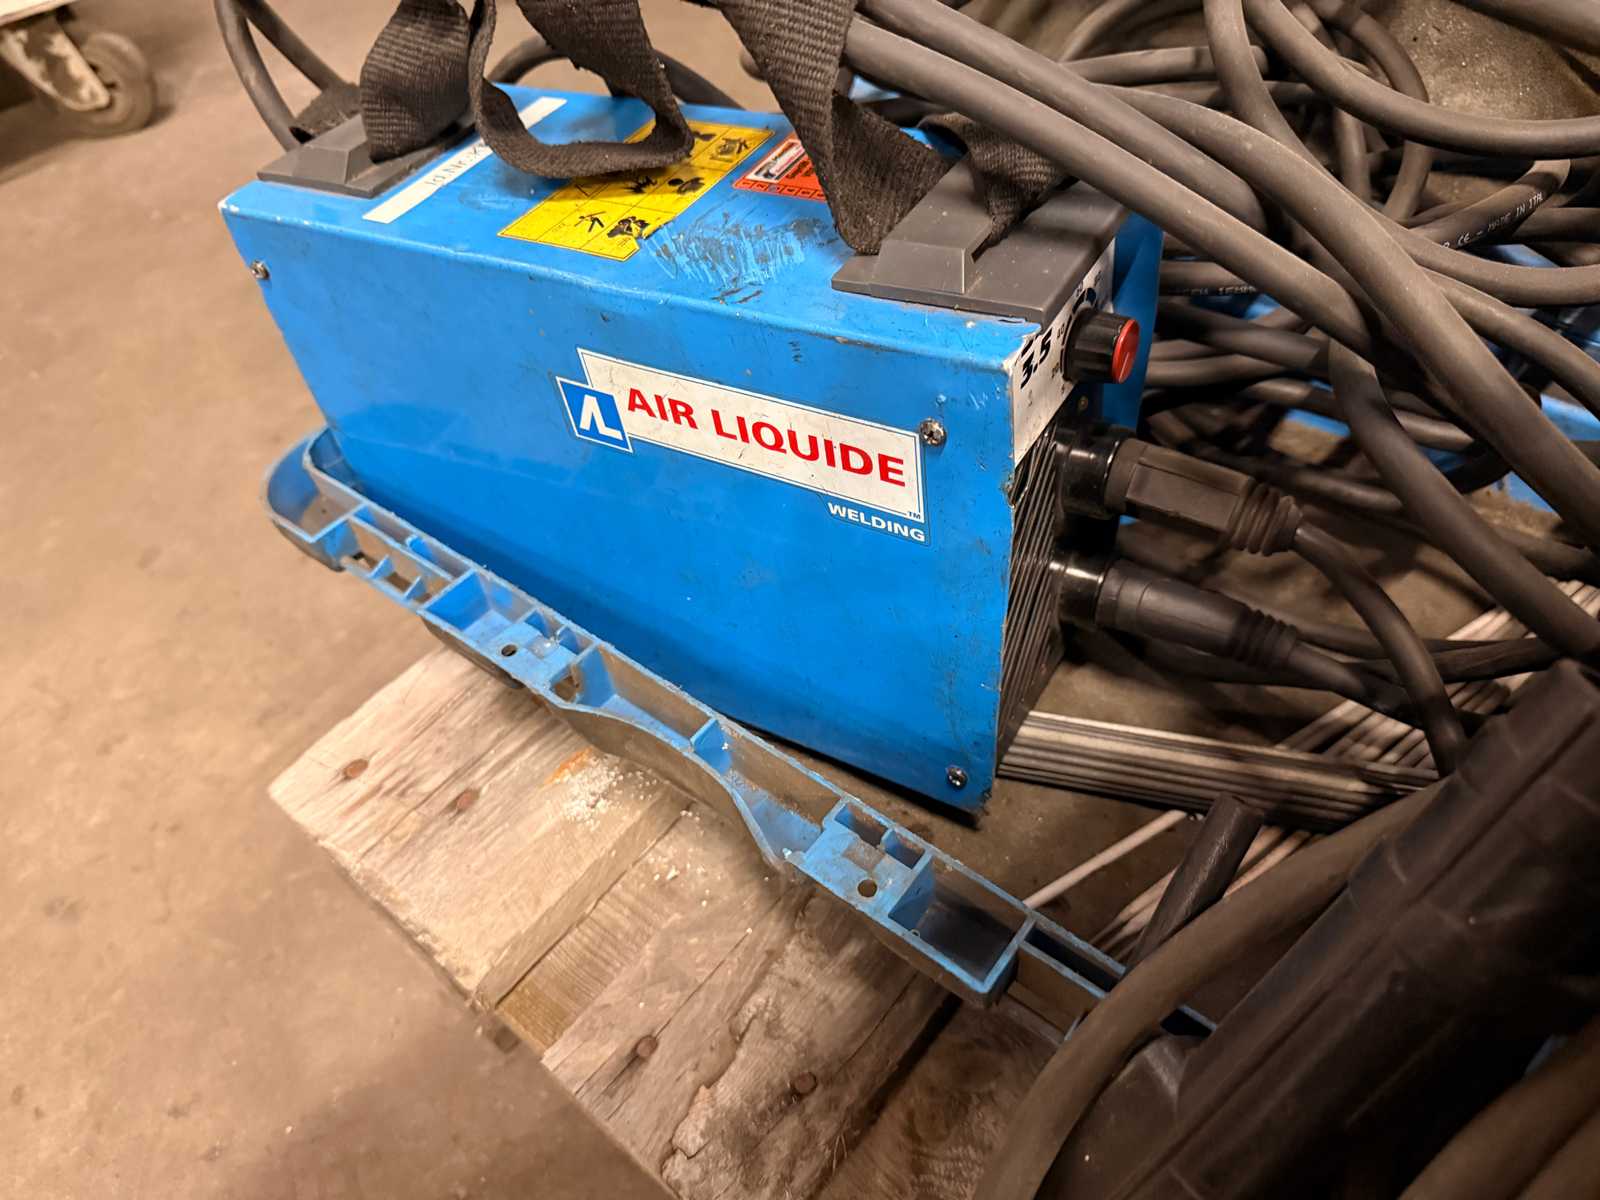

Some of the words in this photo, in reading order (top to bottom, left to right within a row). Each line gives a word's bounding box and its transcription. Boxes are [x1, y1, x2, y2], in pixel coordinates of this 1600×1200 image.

[627, 387, 698, 430] AIR
[711, 409, 906, 487] LIQUIDE
[827, 502, 926, 542] WELDING
